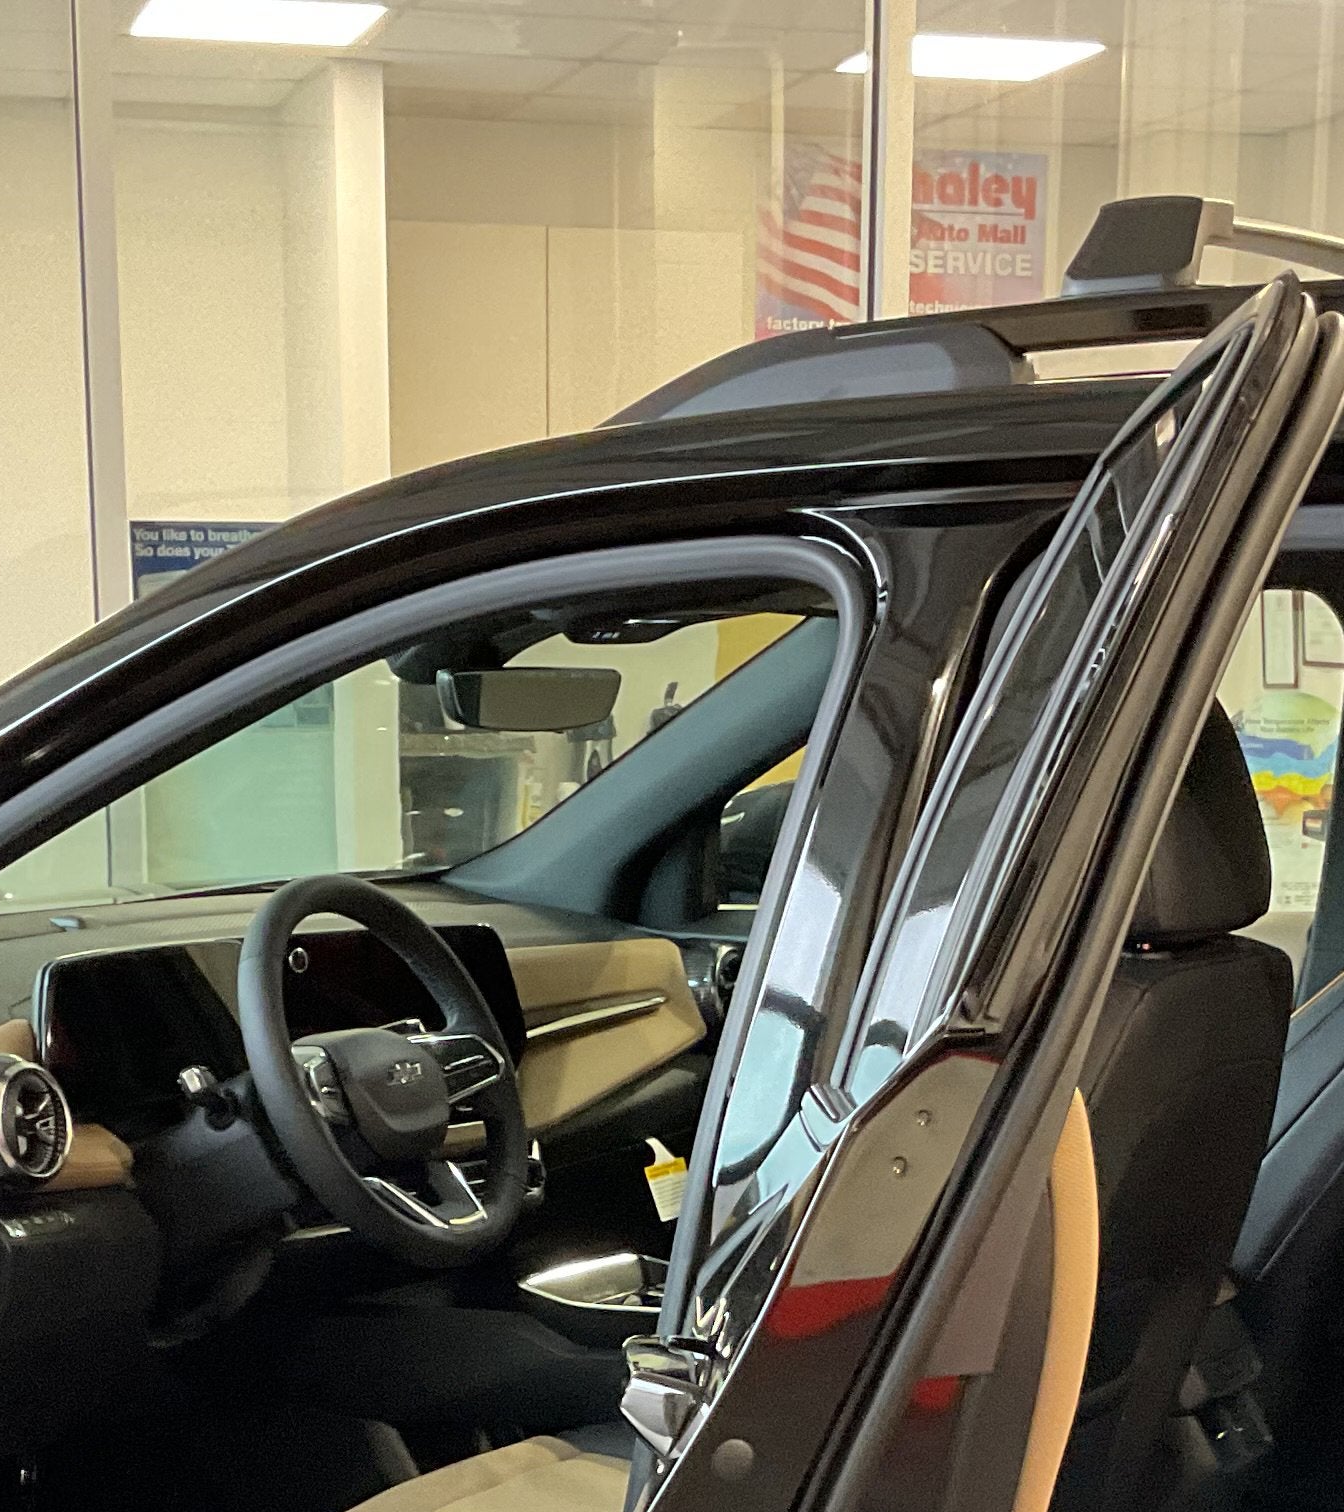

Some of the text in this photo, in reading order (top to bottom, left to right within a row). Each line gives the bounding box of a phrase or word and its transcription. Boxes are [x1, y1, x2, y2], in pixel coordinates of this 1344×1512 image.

[977, 224, 1026, 244] Mall
[909, 249, 1033, 277] SERVICE
[133, 528, 159, 541] You
[162, 528, 187, 541] like
[190, 529, 204, 541] to
[134, 543, 154, 557] So
[157, 544, 191, 557] does
